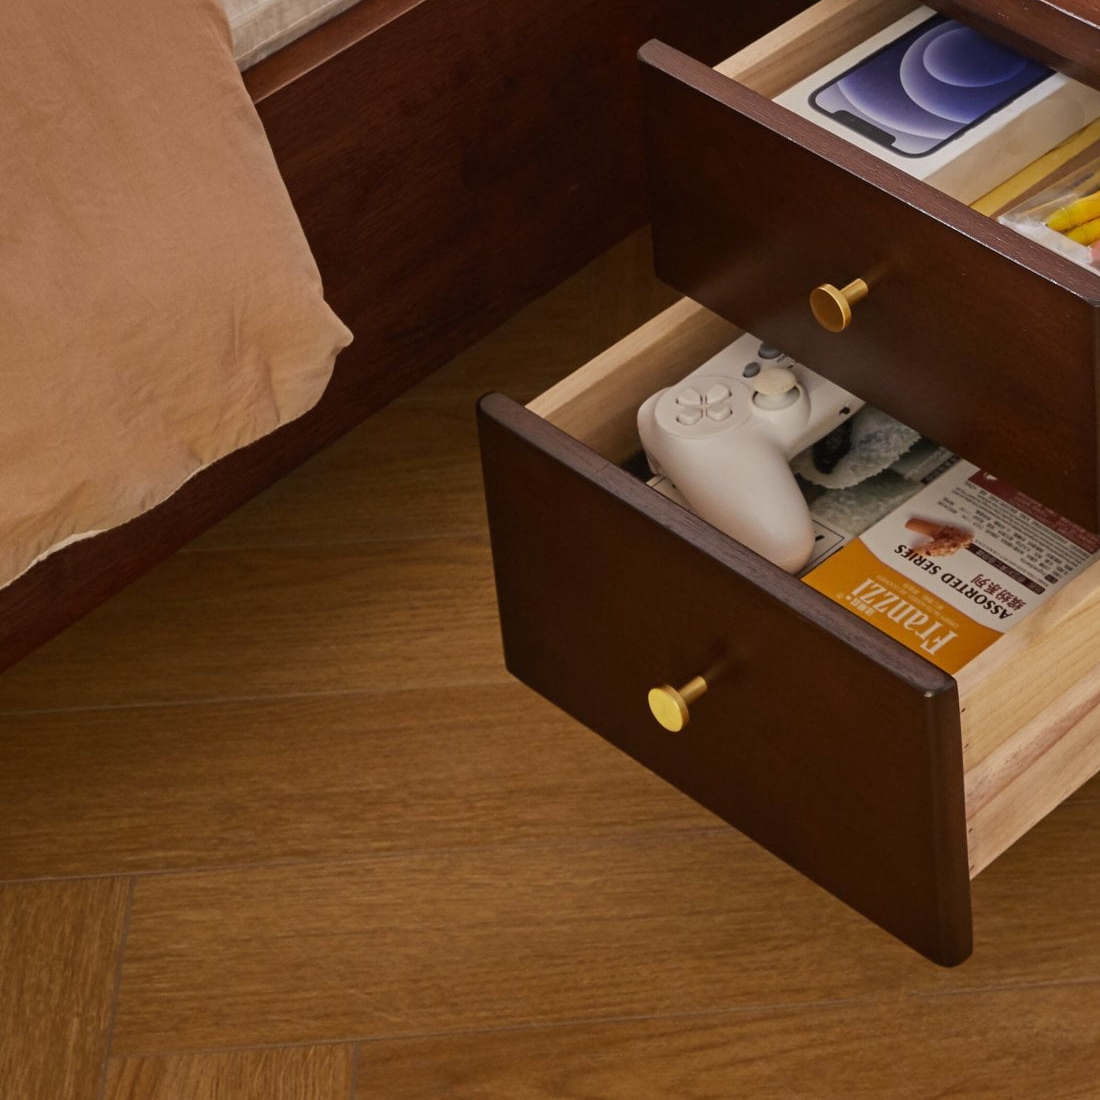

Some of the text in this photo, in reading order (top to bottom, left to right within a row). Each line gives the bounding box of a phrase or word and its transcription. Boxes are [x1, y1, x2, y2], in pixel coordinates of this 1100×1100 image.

[894, 543, 942, 576] SERIES
[940, 571, 1013, 620] ASSORTED
[972, 573, 1026, 611] 缤纷系列
[847, 577, 959, 656] Franzzi
